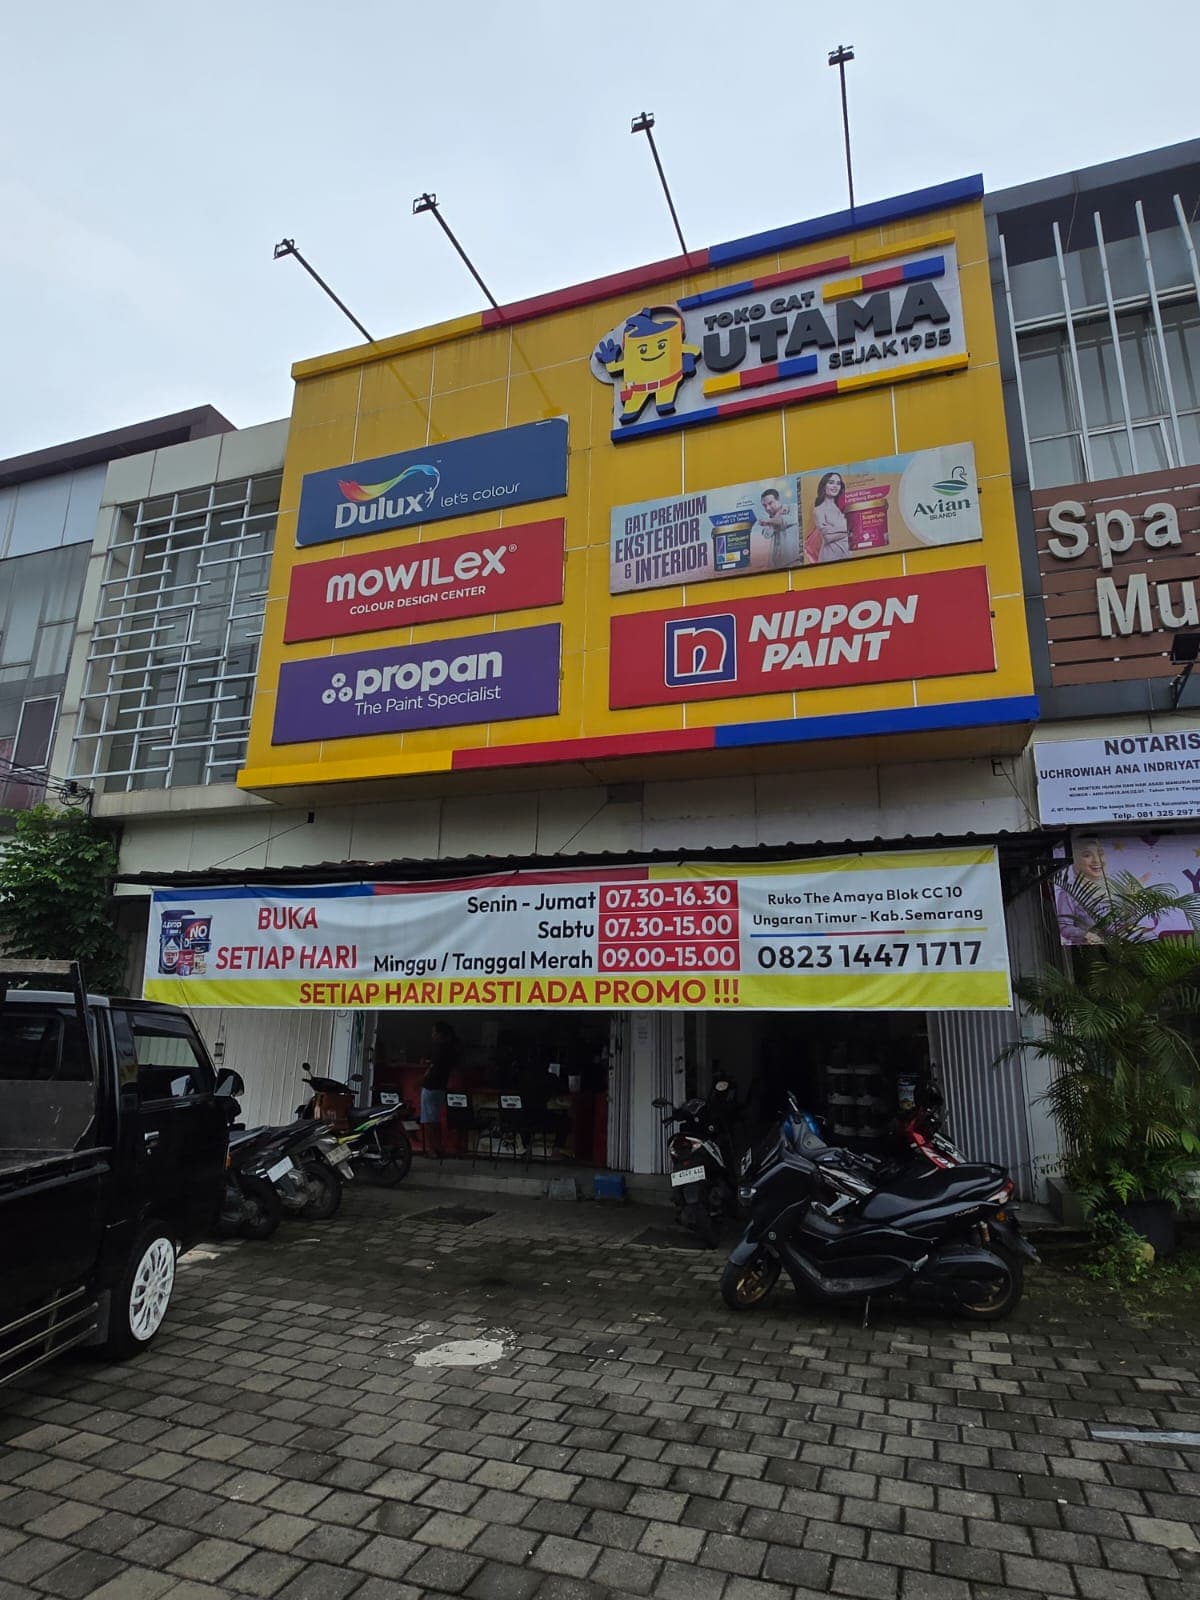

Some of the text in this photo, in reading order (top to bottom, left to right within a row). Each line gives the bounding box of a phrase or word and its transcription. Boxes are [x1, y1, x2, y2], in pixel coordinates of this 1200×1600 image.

[704, 291, 815, 331] TOKO CAT
[703, 282, 950, 372] UTAMA
[829, 328, 951, 369] SEJAK 1955
[440, 482, 520, 508] let's colour
[913, 499, 971, 517] Avian
[335, 493, 424, 529] Dulux
[625, 512, 648, 533] CAT
[649, 495, 707, 527] PREMIUM
[929, 511, 957, 520] BRANDS
[615, 518, 700, 563] EKSTERIOR
[1048, 499, 1183, 569] Spa
[635, 541, 708, 585] INTERIOR
[350, 585, 486, 616] COLOUR DESIGN CENTER
[1096, 573, 1199, 638] Mu
[748, 594, 918, 643] NIPPON
[761, 631, 890, 673] PAINT
[355, 651, 503, 700] propan
[355, 685, 502, 716] The Paint Specialist
[1104, 732, 1200, 756] NOTARIS
[1040, 766, 1111, 780] UCHROWIAH
[1115, 764, 1140, 774] ANA
[1112, 812, 1134, 821] Telp.
[1157, 809, 1174, 817] 325
[1177, 808, 1193, 816] 297
[467, 894, 517, 914] Senin
[534, 891, 597, 912] Jumat
[605, 885, 732, 910] 07.30-16.30
[768, 893, 801, 906] Ruko
[804, 892, 832, 904] The
[833, 889, 883, 906] Amaya
[886, 886, 919, 901] Blok
[258, 906, 318, 930] BUKA
[537, 920, 595, 939] Sabtu
[604, 915, 733, 938] 07.30-15.00
[753, 913, 814, 928] Ungaran
[815, 911, 857, 925] Timur
[190, 925, 208, 938] NO
[215, 944, 358, 970] SETIAP HARI
[374, 954, 438, 976] Minggu
[453, 952, 525, 974] Tanggal
[530, 950, 593, 970] Merah
[601, 945, 736, 969] 09.00-15.00
[757, 940, 982, 970] 0823 1447 1717
[300, 978, 740, 1005] SETIAP HARI PASTI ADA PROMO !!!
